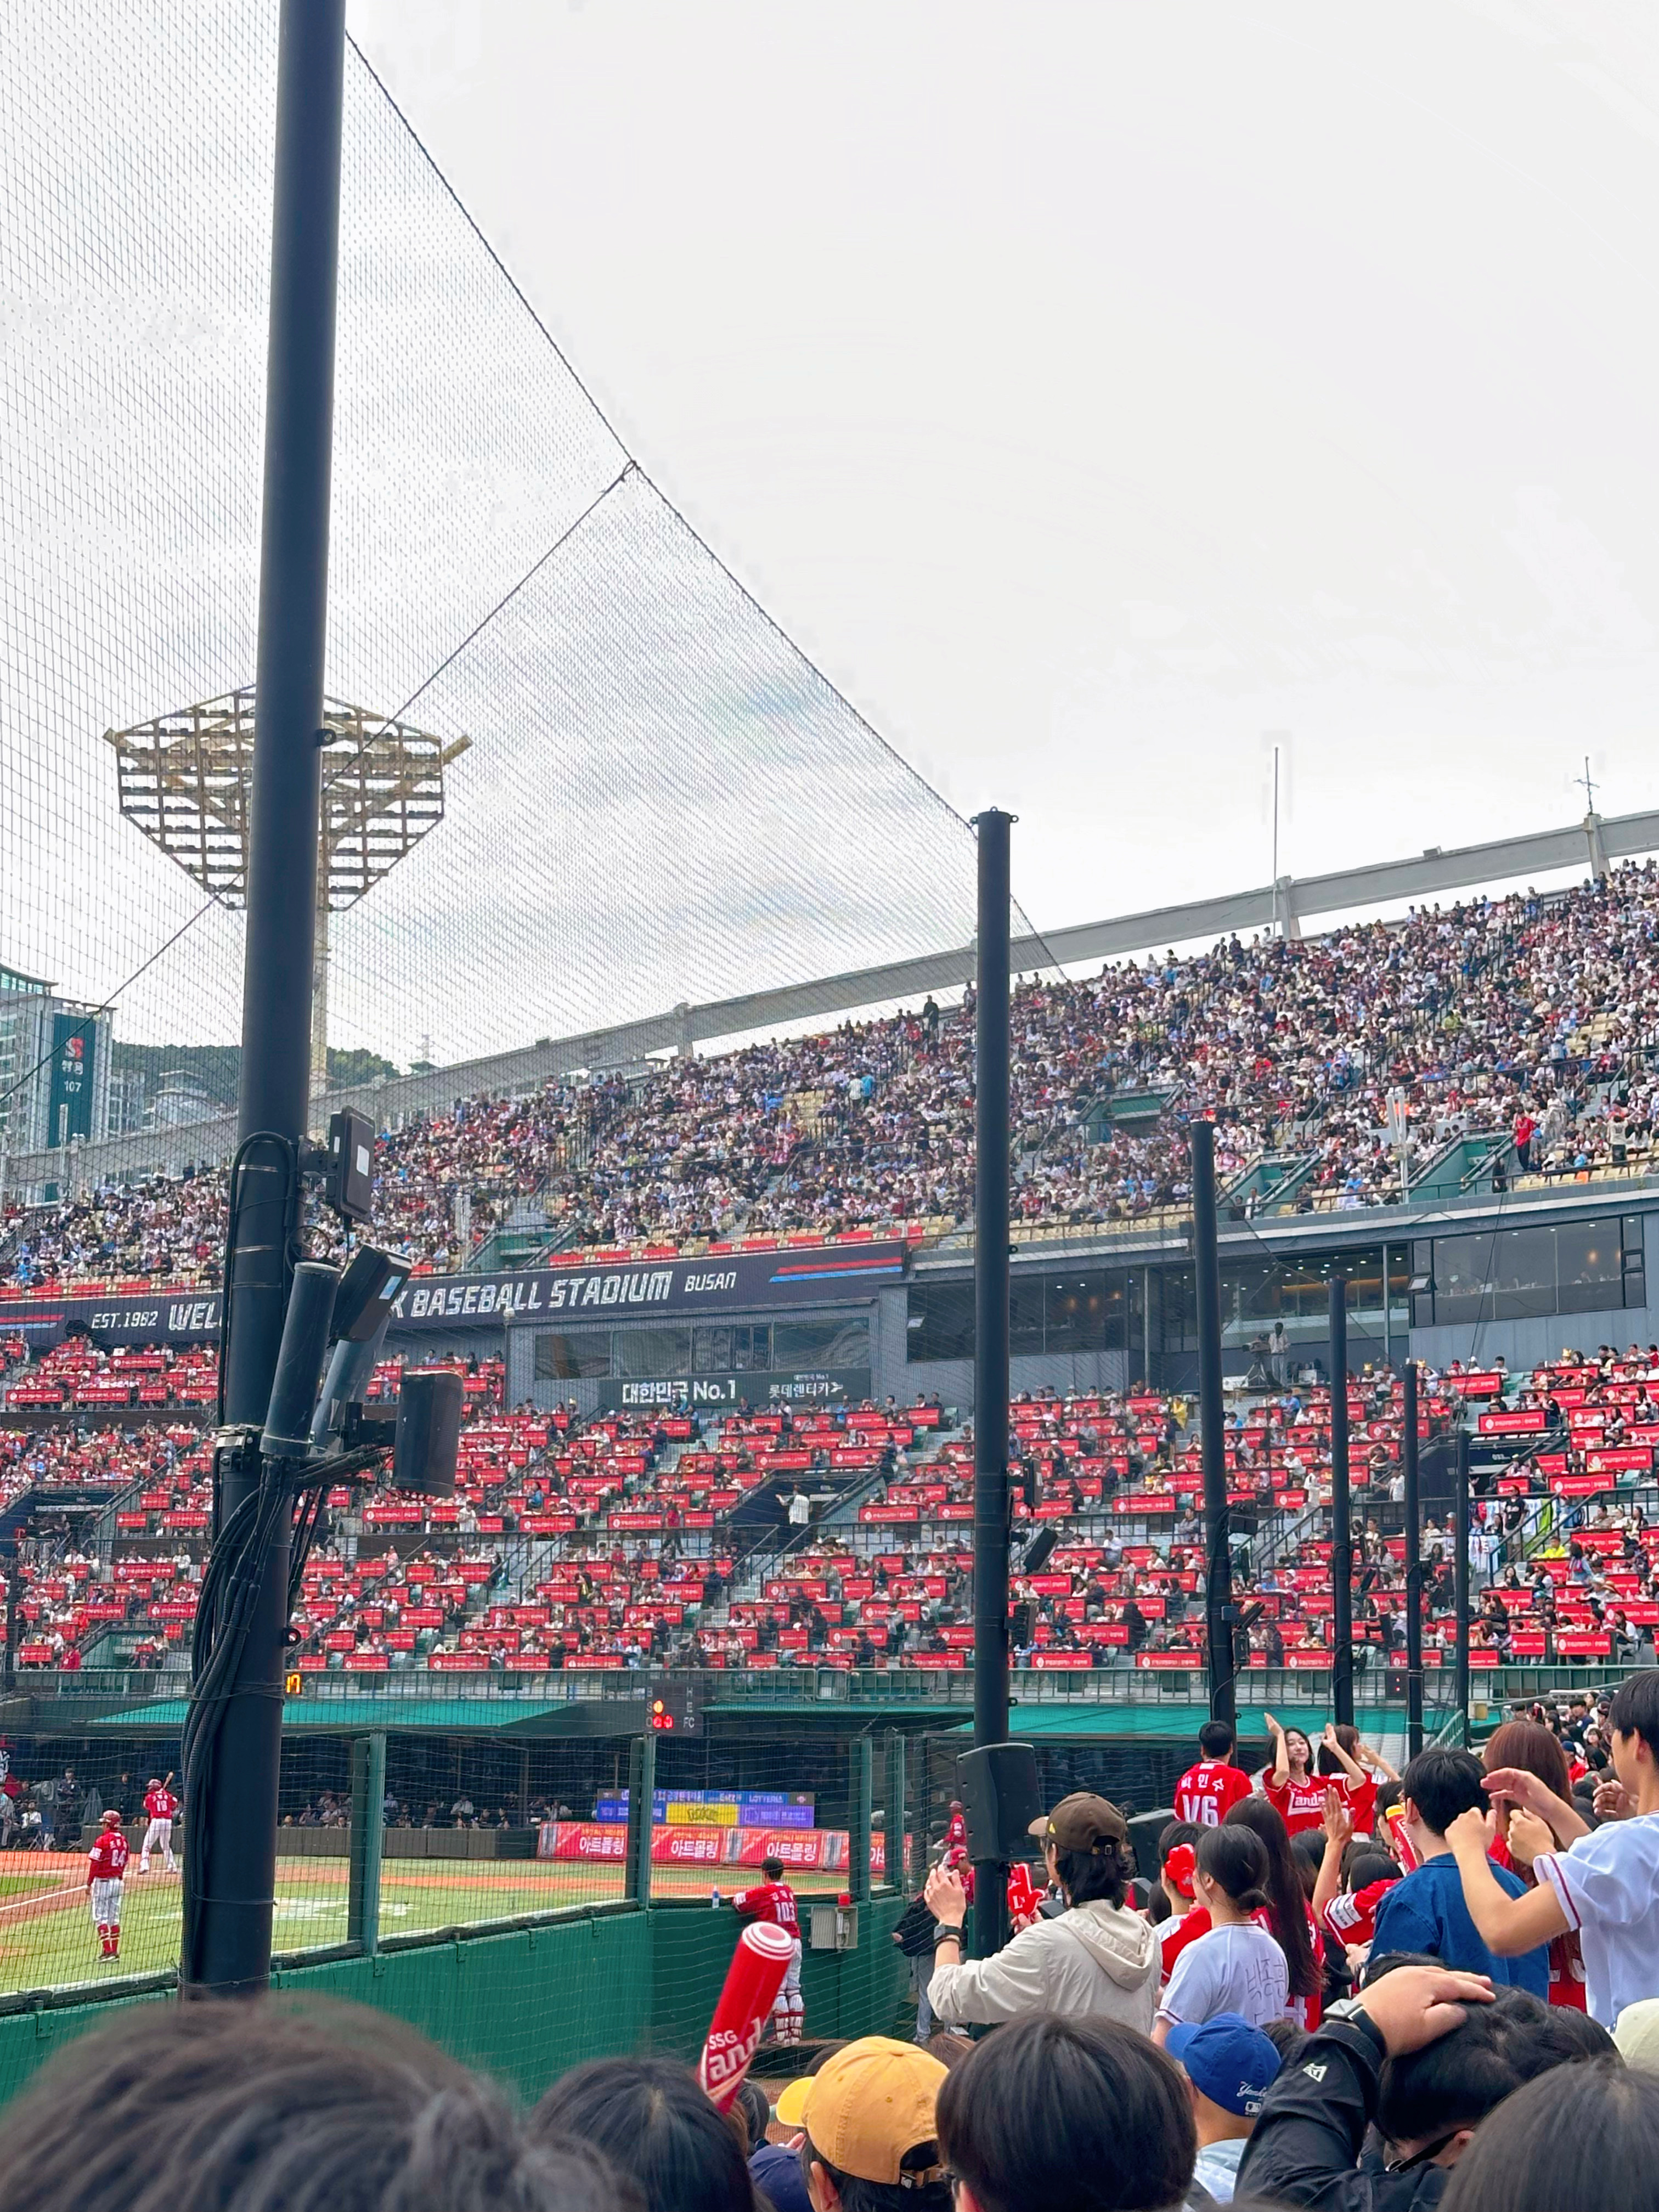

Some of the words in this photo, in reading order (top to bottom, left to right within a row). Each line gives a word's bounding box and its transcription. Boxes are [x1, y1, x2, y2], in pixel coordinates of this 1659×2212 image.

[64, 1080, 82, 1093] 107
[411, 1281, 543, 1318] BASEBALL
[548, 1271, 673, 1308] STADIUM
[685, 1272, 737, 1292] BUSAN
[91, 1311, 159, 1329] EST.1982
[693, 1379, 736, 1401] No.1
[686, 1702, 693, 1713] E
[1182, 1794, 1219, 1828] V6
[766, 1842, 816, 1862] 아트몰링
[708, 2030, 738, 2050] SSG
